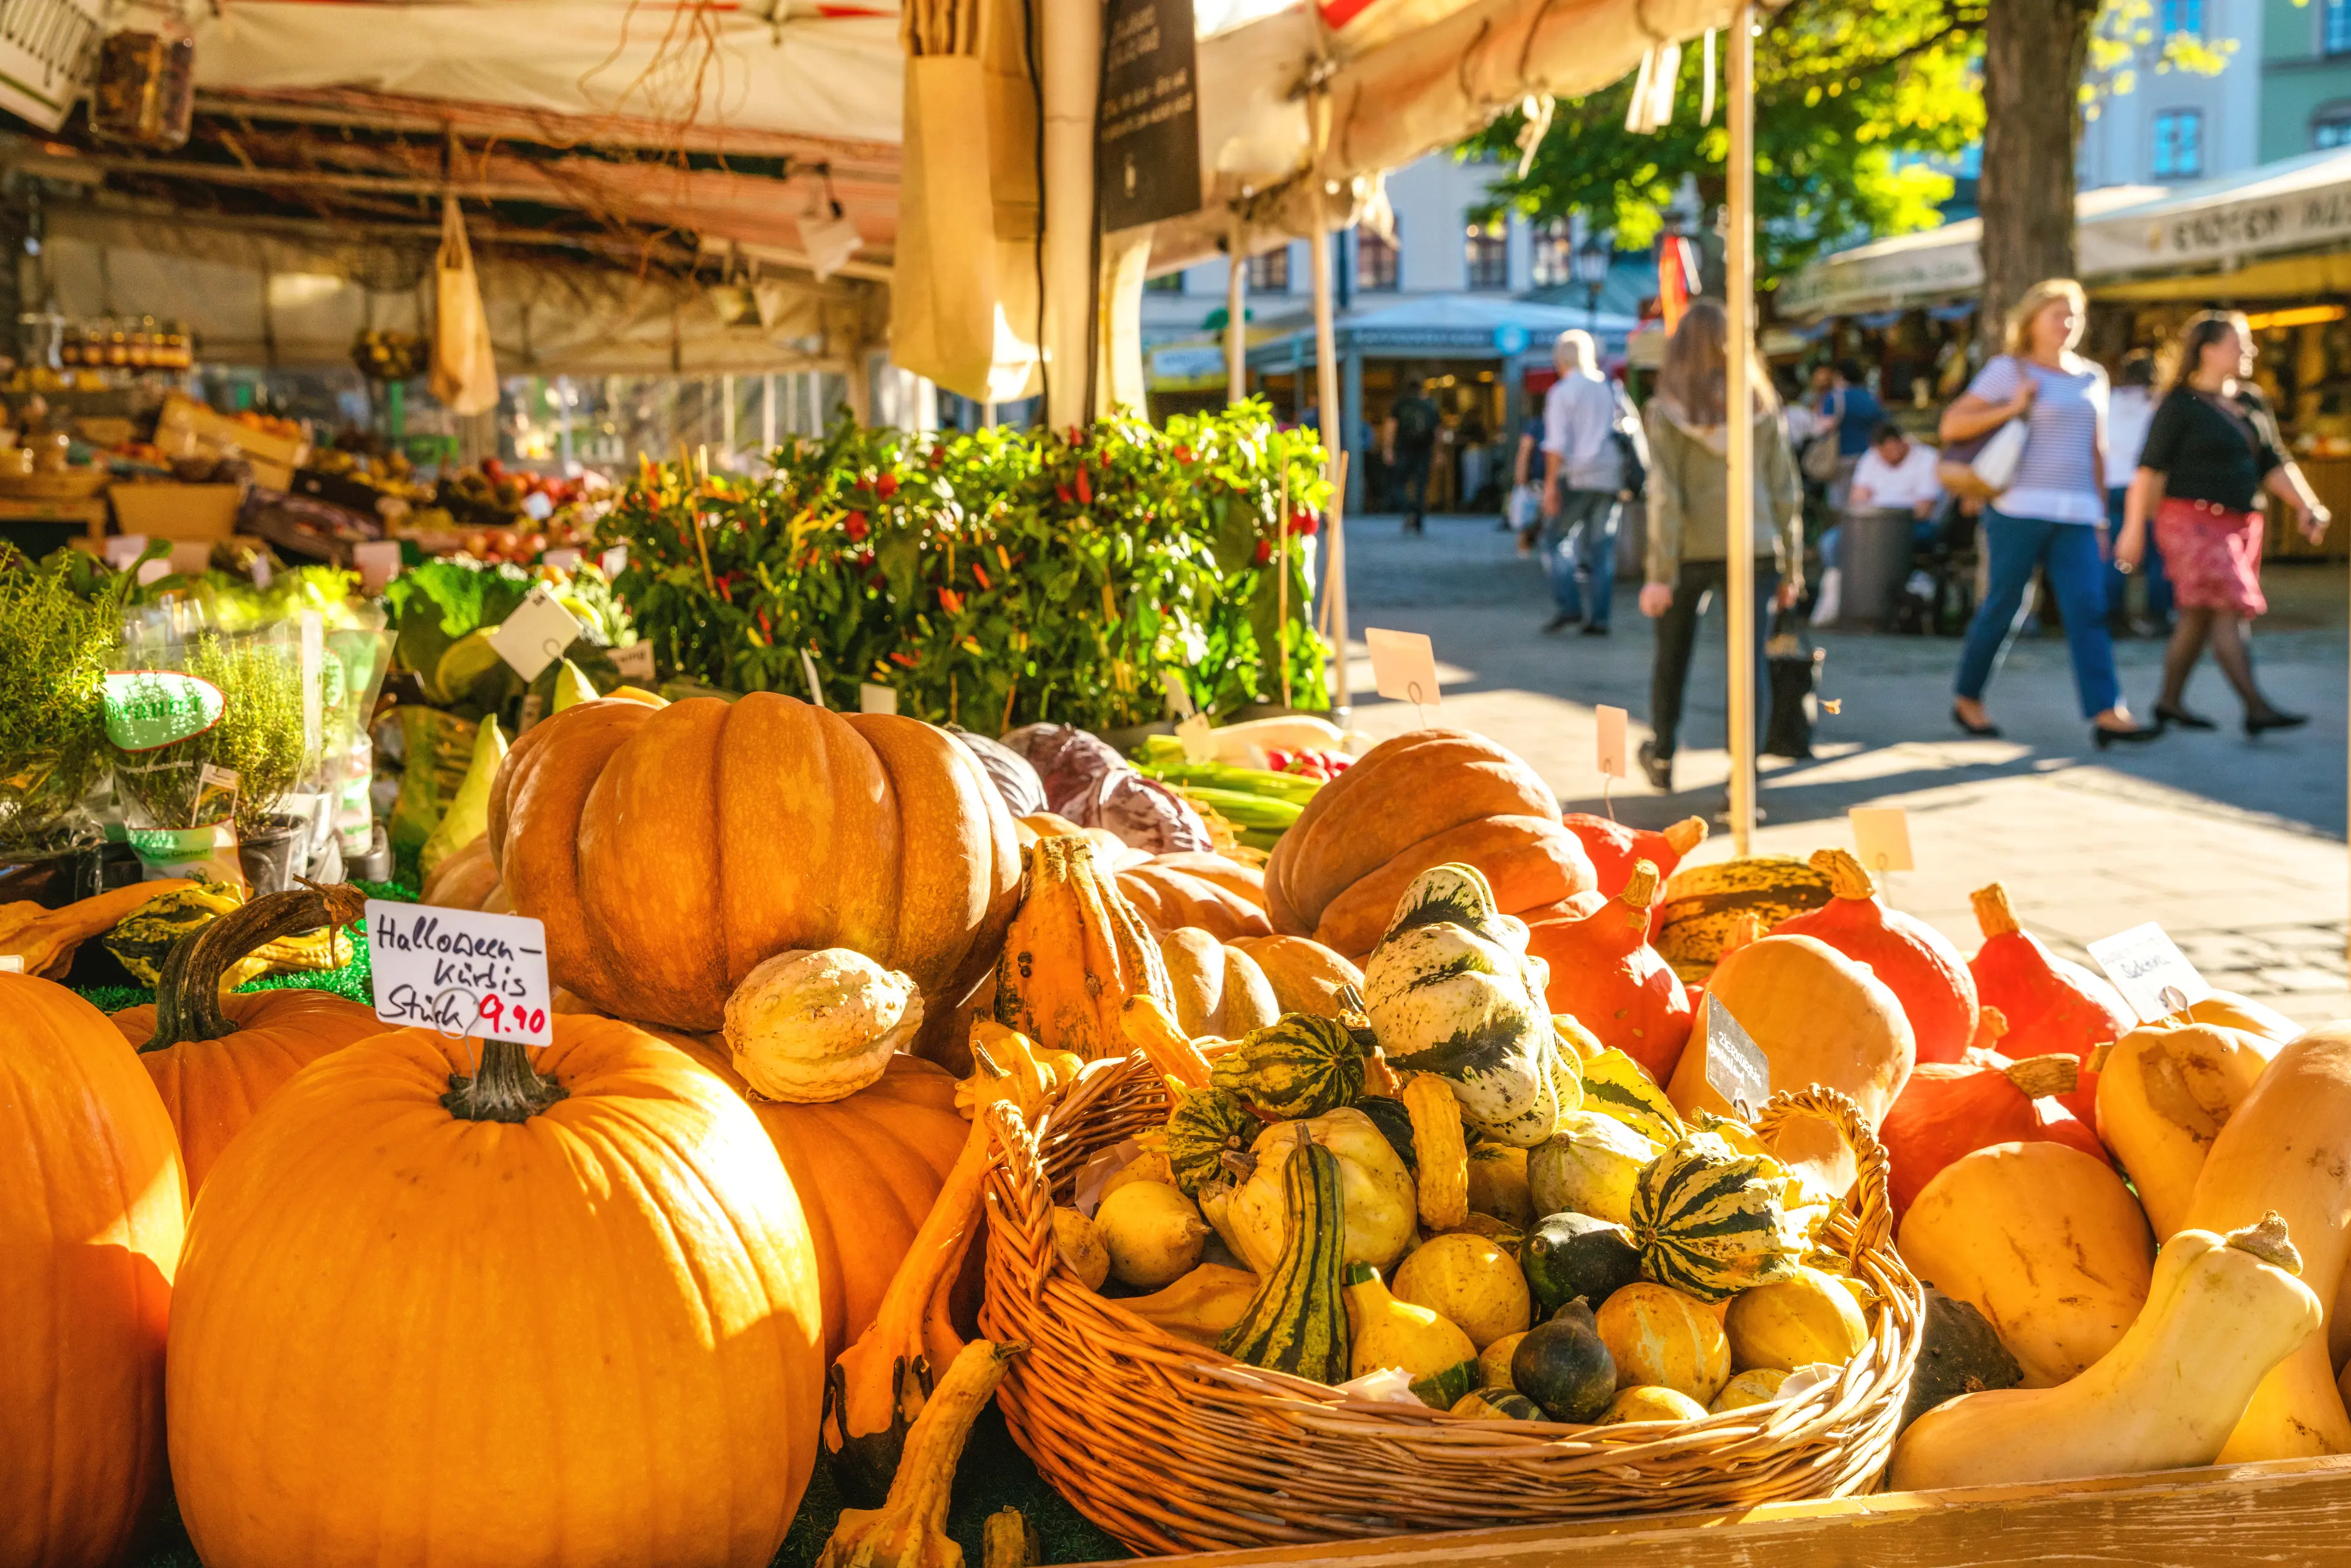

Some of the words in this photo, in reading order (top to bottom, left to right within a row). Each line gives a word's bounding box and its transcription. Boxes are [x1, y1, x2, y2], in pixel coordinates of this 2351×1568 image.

[434, 958, 526, 997] Kürbis
[378, 983, 463, 1029] Stück
[479, 994, 545, 1034] 9.90
